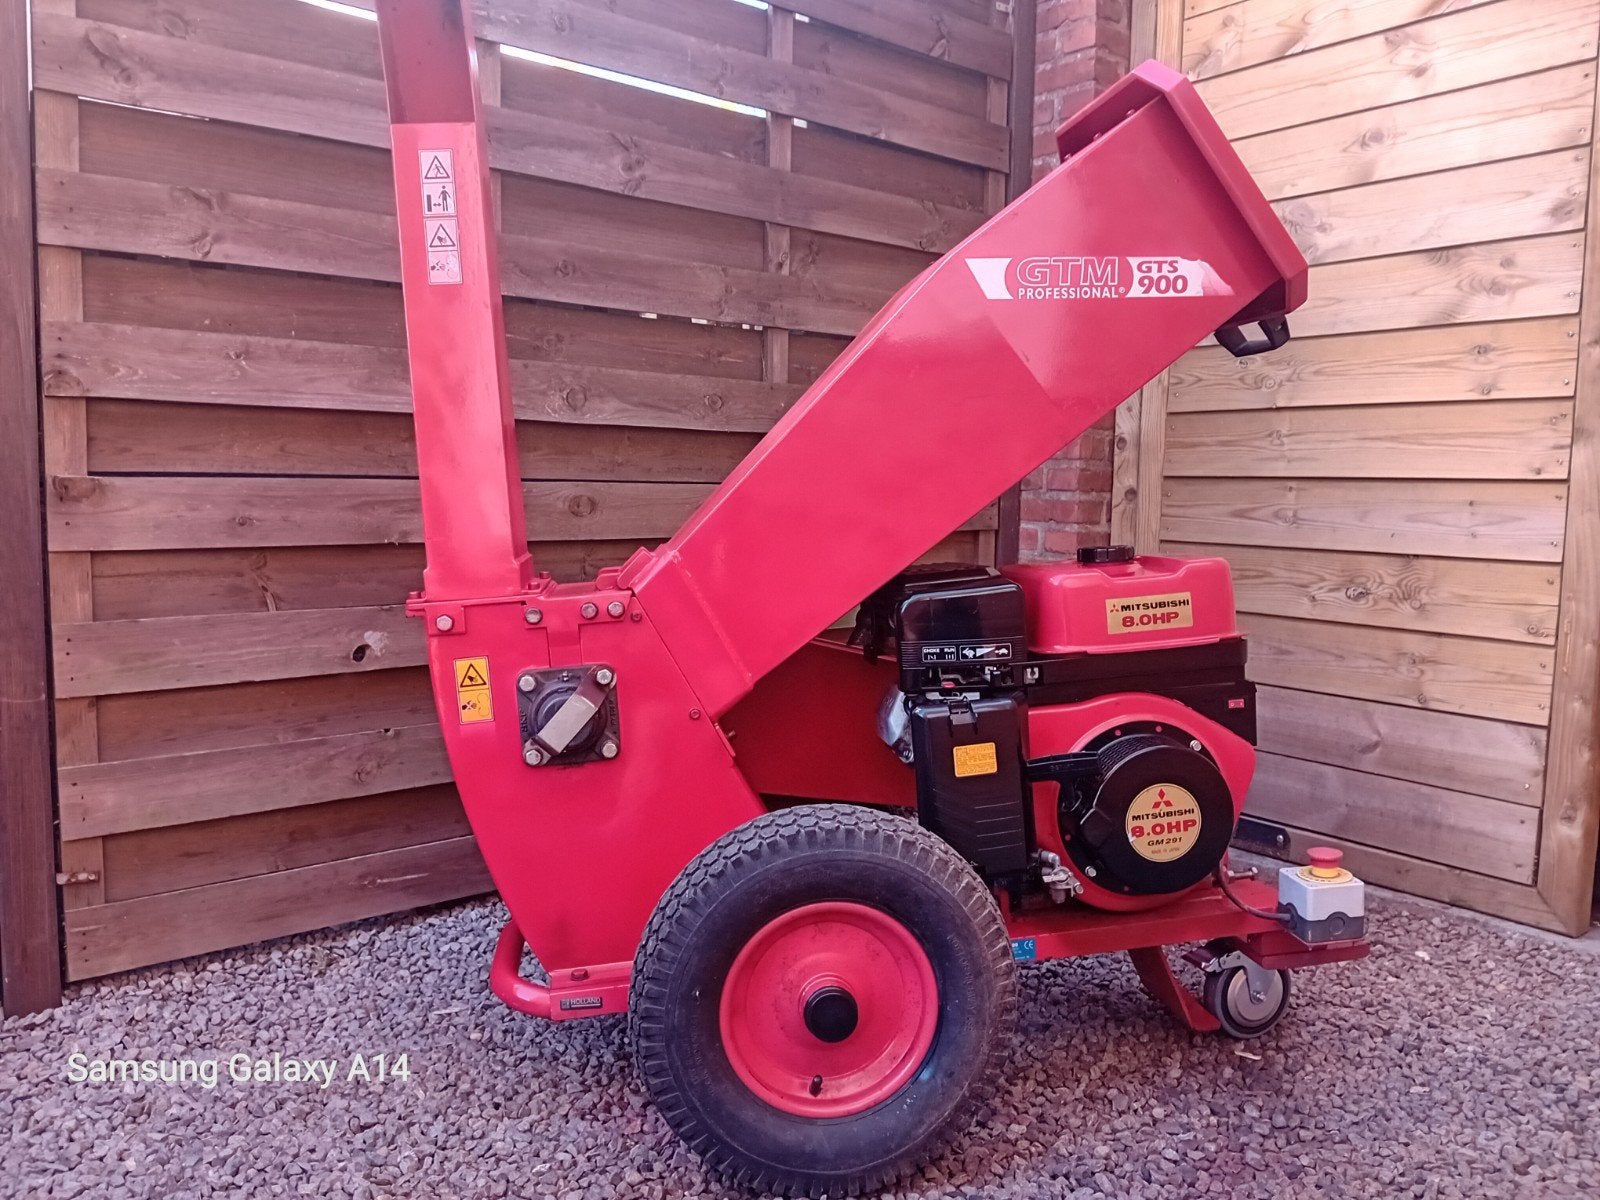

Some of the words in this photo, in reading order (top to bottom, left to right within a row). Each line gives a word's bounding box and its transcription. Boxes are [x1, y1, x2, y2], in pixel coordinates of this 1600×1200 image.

[1016, 256, 1118, 286] GTM
[1137, 260, 1178, 273] GTS
[1138, 275, 1188, 294] 900
[1120, 599, 1189, 612] MITSUBISHI
[1122, 611, 1179, 628] 8.0HP
[1131, 808, 1194, 821] MITSUBISHI
[1131, 819, 1197, 838] 8.0HP
[571, 997, 600, 1005] HOLLAND
